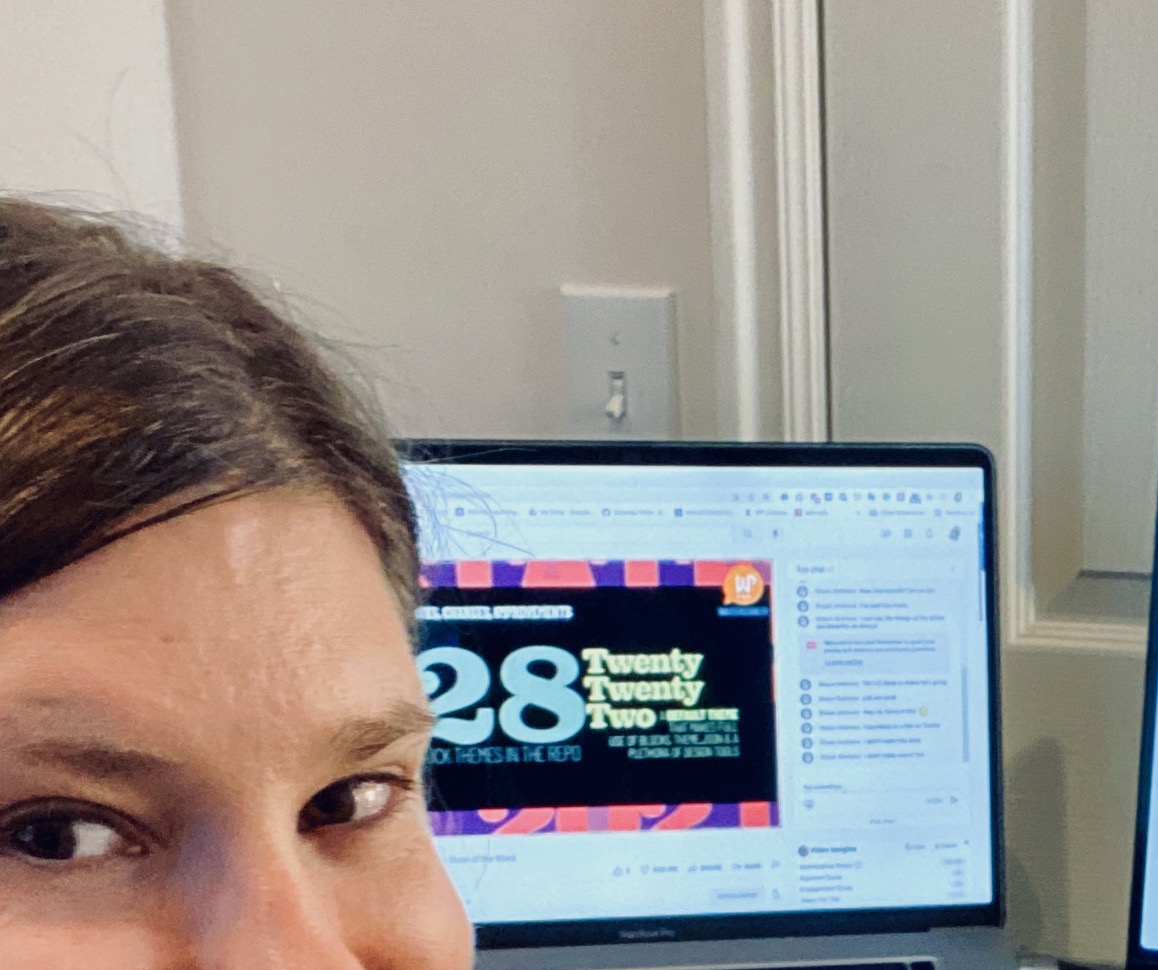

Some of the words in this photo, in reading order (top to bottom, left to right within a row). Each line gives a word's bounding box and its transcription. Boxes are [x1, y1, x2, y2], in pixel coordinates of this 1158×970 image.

[582, 648, 704, 679] Twenty
[416, 645, 588, 746] 28
[582, 676, 706, 706] Twenty
[585, 703, 658, 730] Two
